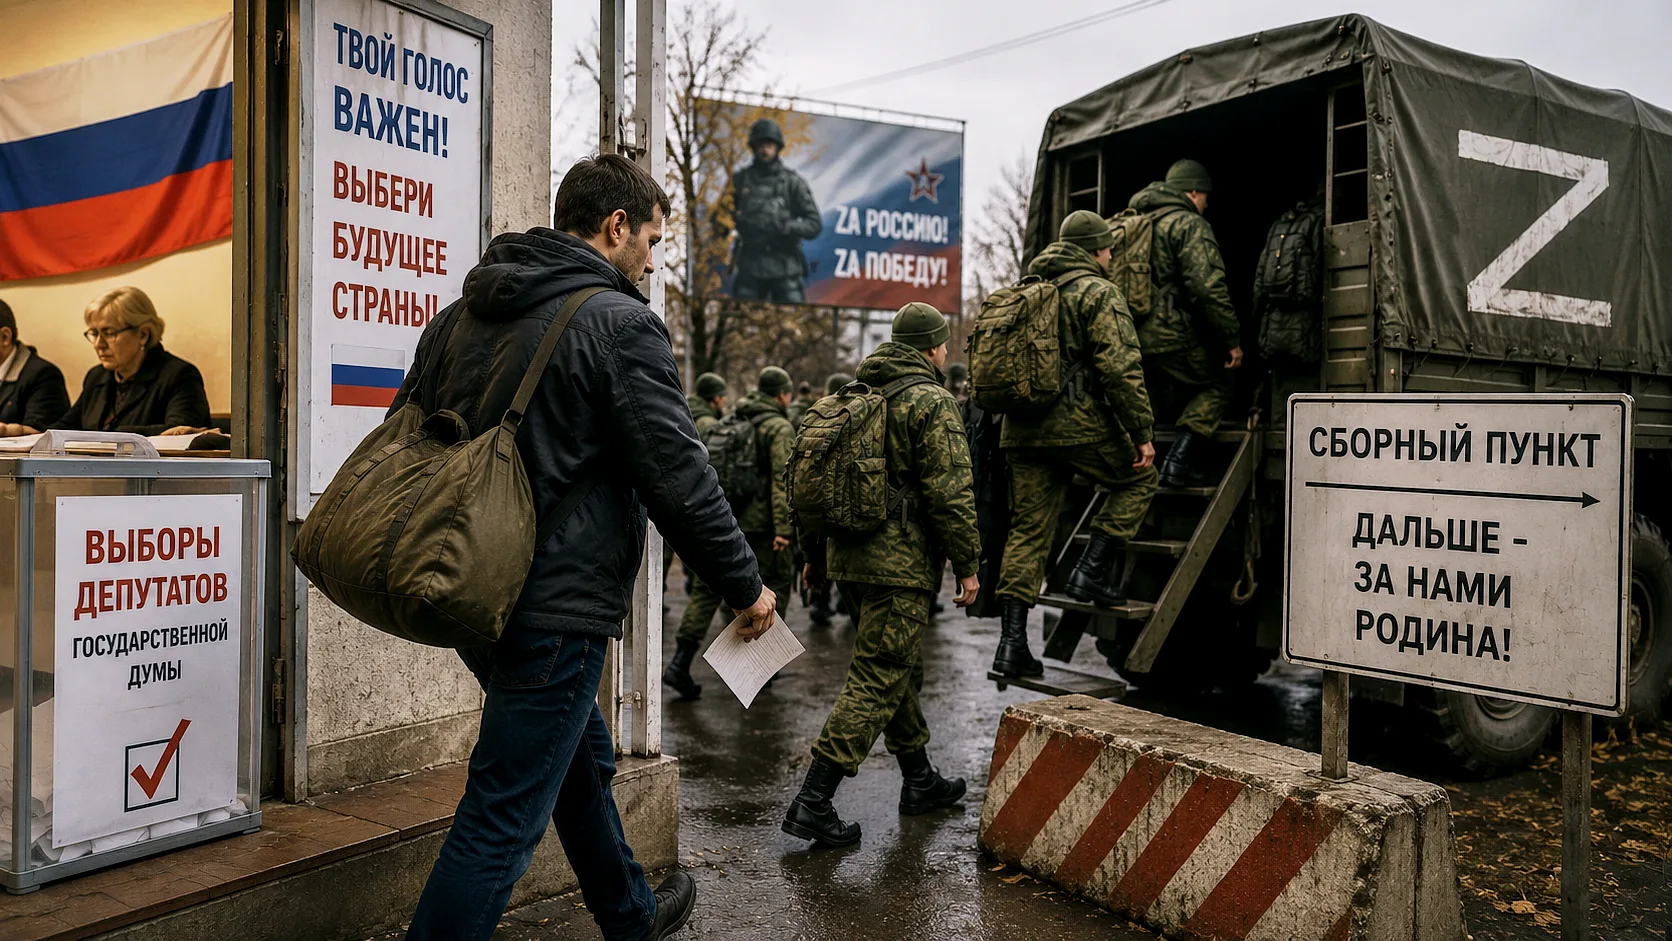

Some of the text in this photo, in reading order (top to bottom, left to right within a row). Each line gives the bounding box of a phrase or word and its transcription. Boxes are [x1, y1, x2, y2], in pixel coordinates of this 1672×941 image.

[333, 22, 469, 104] ТВОЙ ГОЛОС
[334, 85, 448, 158] ВАЖЕН!
[333, 160, 433, 218] ВЫБЕРИ
[333, 221, 447, 278] БУДУЩЕЕ
[866, 208, 948, 244] РОССИЮ!
[1458, 129, 1612, 328] Z
[865, 251, 947, 288] ПОБЕДУ!
[1309, 422, 1601, 468] СБОРНЫЙ ПУНКТ
[85, 525, 220, 565] ВЫБОРЫ
[1352, 512, 1500, 554] ДАЛЬШЕ
[73, 572, 228, 621] ДЕПУТАТОВ
[1354, 560, 1511, 609] ЗА НАМИ
[73, 617, 228, 659] ГОСУДАРСТВЕННОЙ
[1355, 609, 1511, 662] РОДИНА!
[128, 660, 182, 690] ДУМЫ
